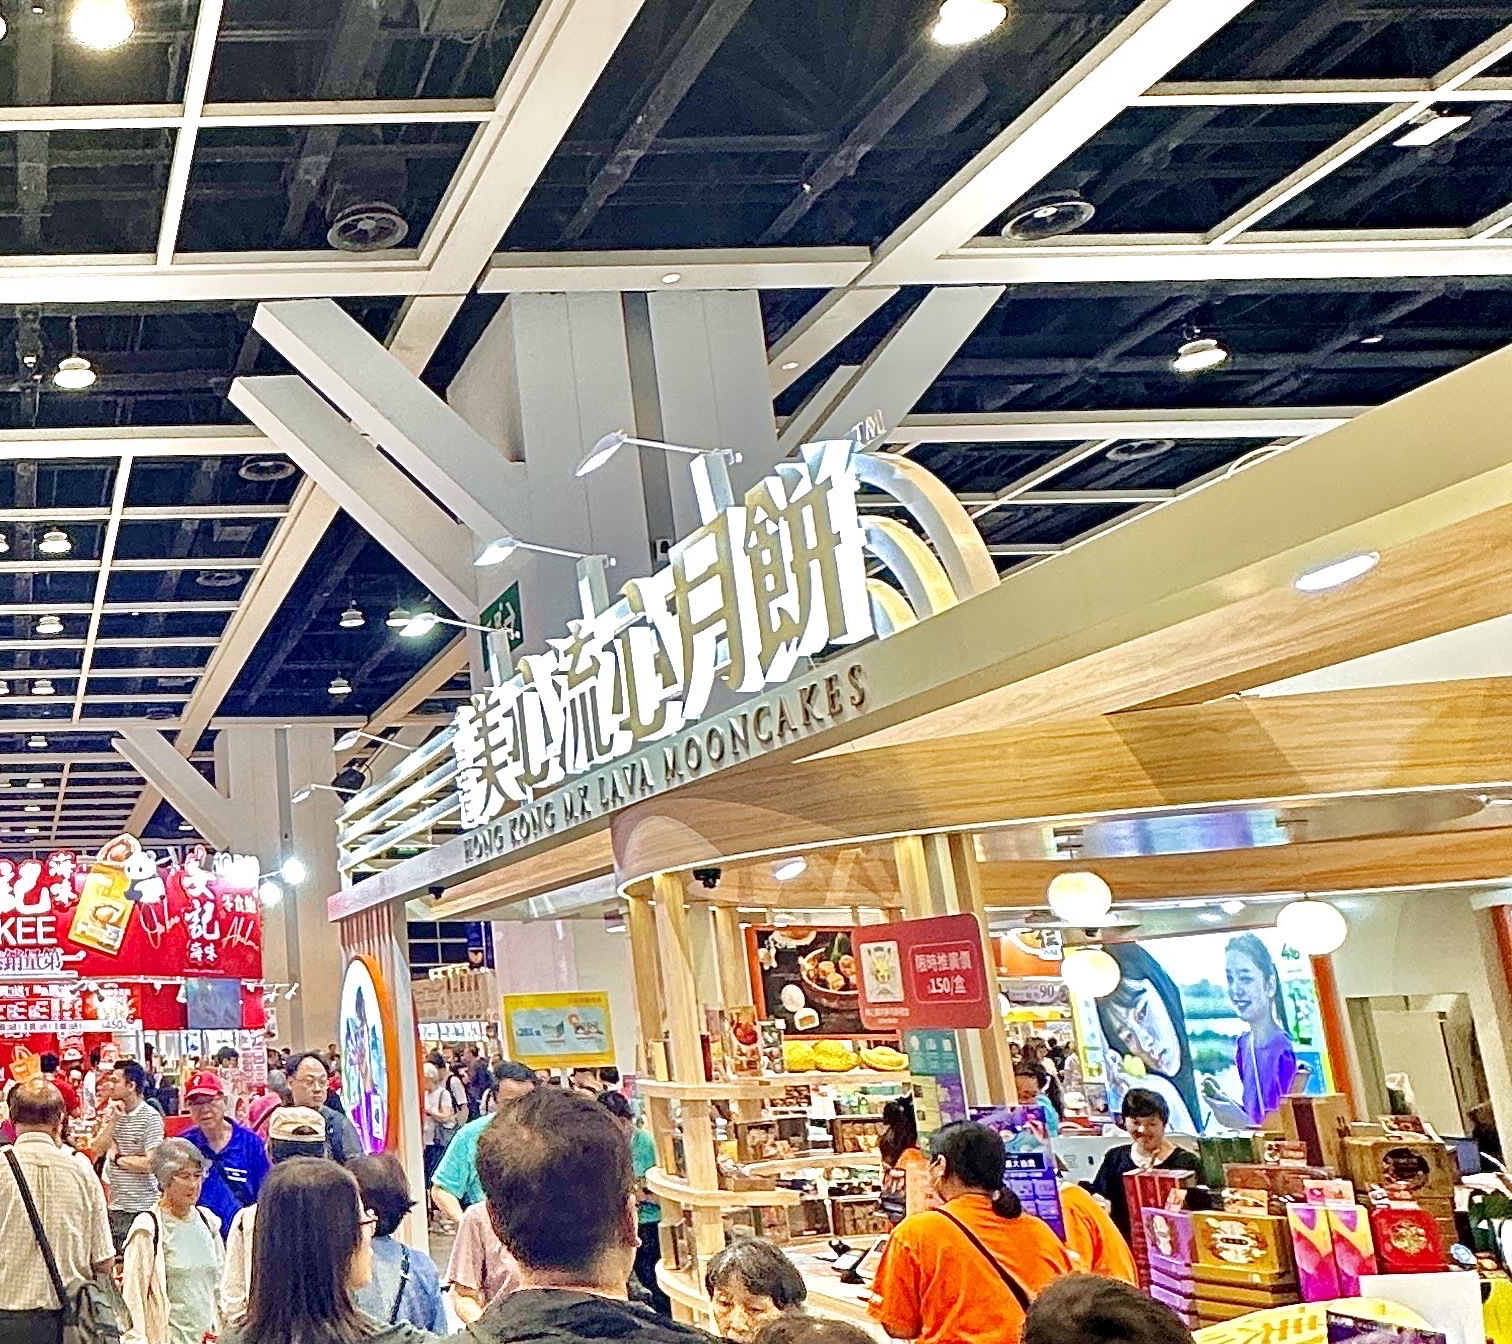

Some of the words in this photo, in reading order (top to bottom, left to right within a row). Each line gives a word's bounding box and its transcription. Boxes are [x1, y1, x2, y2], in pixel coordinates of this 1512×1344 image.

[455, 439, 876, 827] 美心流心月餅
[463, 824, 505, 864] HONG
[509, 801, 556, 846] KONG
[598, 757, 655, 806] LAVA
[663, 664, 867, 782] MOONCAKES
